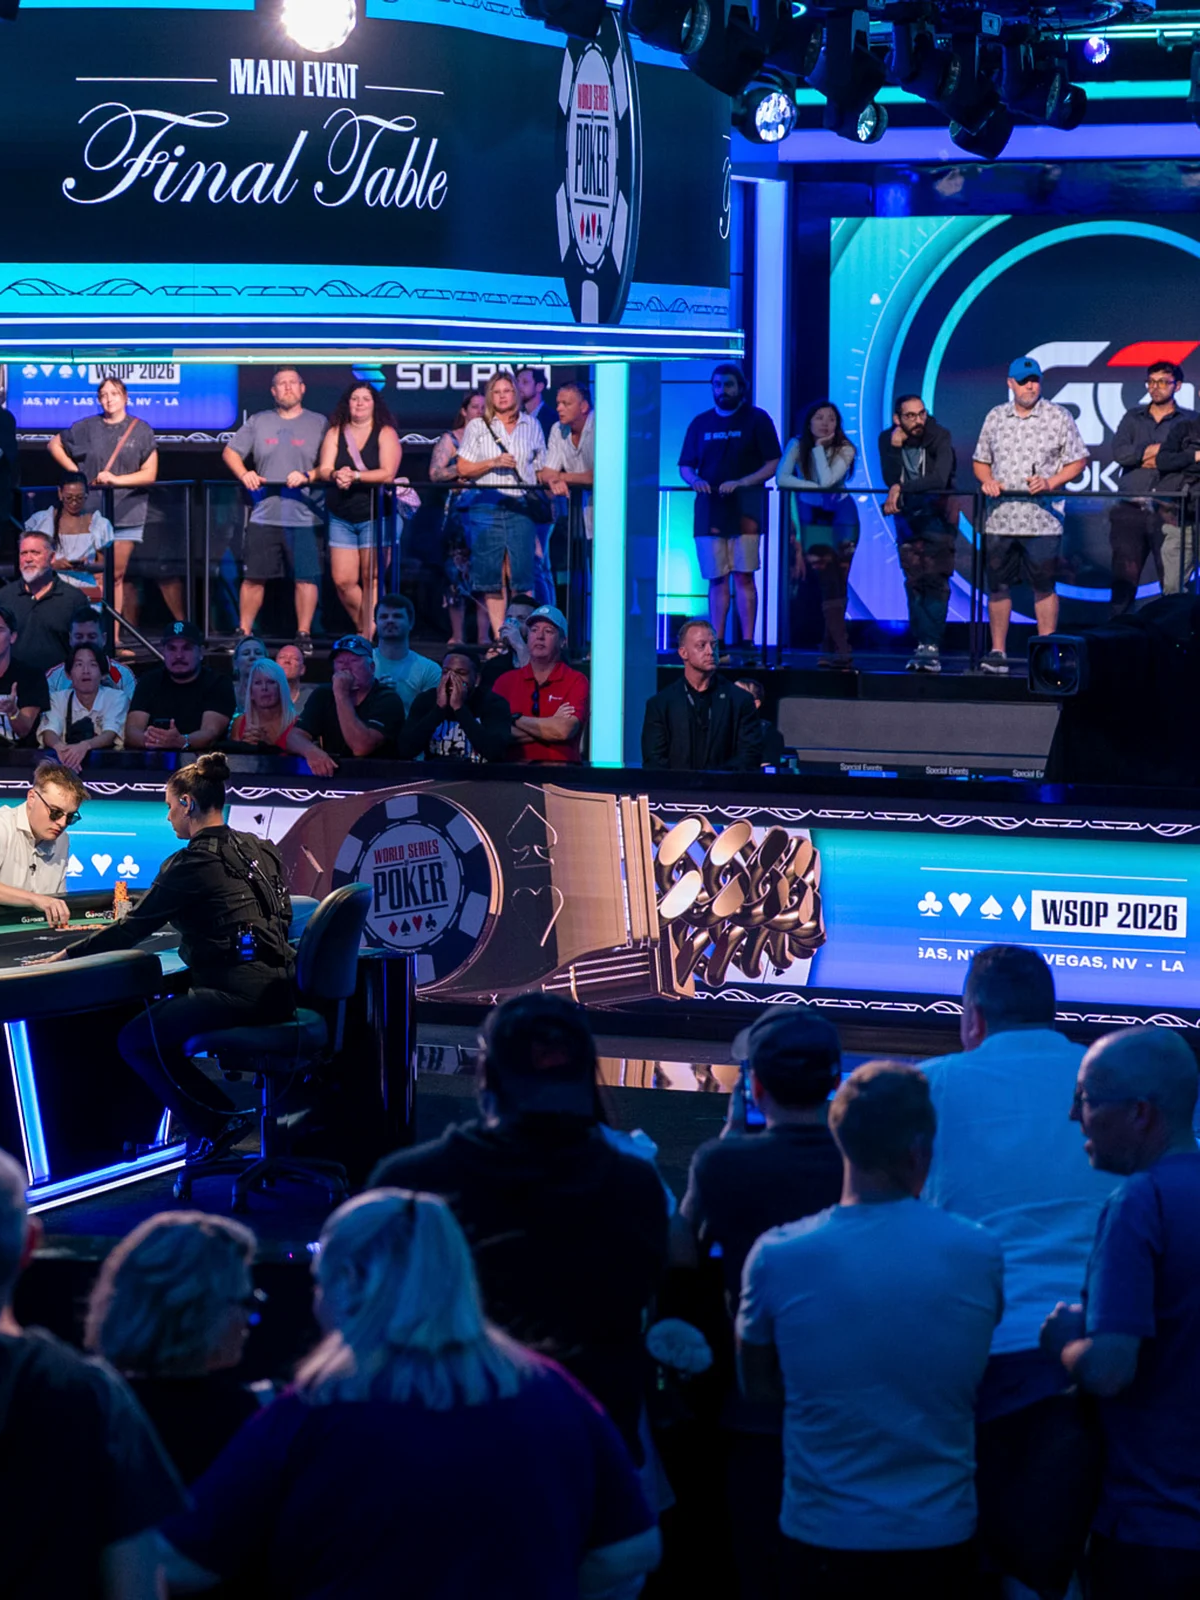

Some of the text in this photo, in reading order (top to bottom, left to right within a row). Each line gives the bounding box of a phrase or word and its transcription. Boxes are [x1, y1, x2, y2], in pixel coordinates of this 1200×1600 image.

[229, 58, 359, 100] MAIN EVENT
[577, 84, 609, 112] WORLD SERIES
[62, 101, 449, 210] Final Table
[574, 122, 610, 198] POKER
[140, 364, 175, 379] 2026
[23, 397, 43, 407] AS,
[45, 397, 60, 406] NV
[73, 397, 94, 406] LAS
[136, 397, 151, 406] NV
[840, 763, 862, 772] Special
[925, 766, 969, 775] Special Events
[1012, 769, 1033, 778] Special
[374, 839, 439, 864] WORLD SERIES
[373, 861, 448, 913] POKER
[1041, 898, 1178, 931] WSOP 2026
[1043, 953, 1108, 970] VEGAS,
[1112, 957, 1138, 970] NV
[1161, 960, 1185, 972] LA
